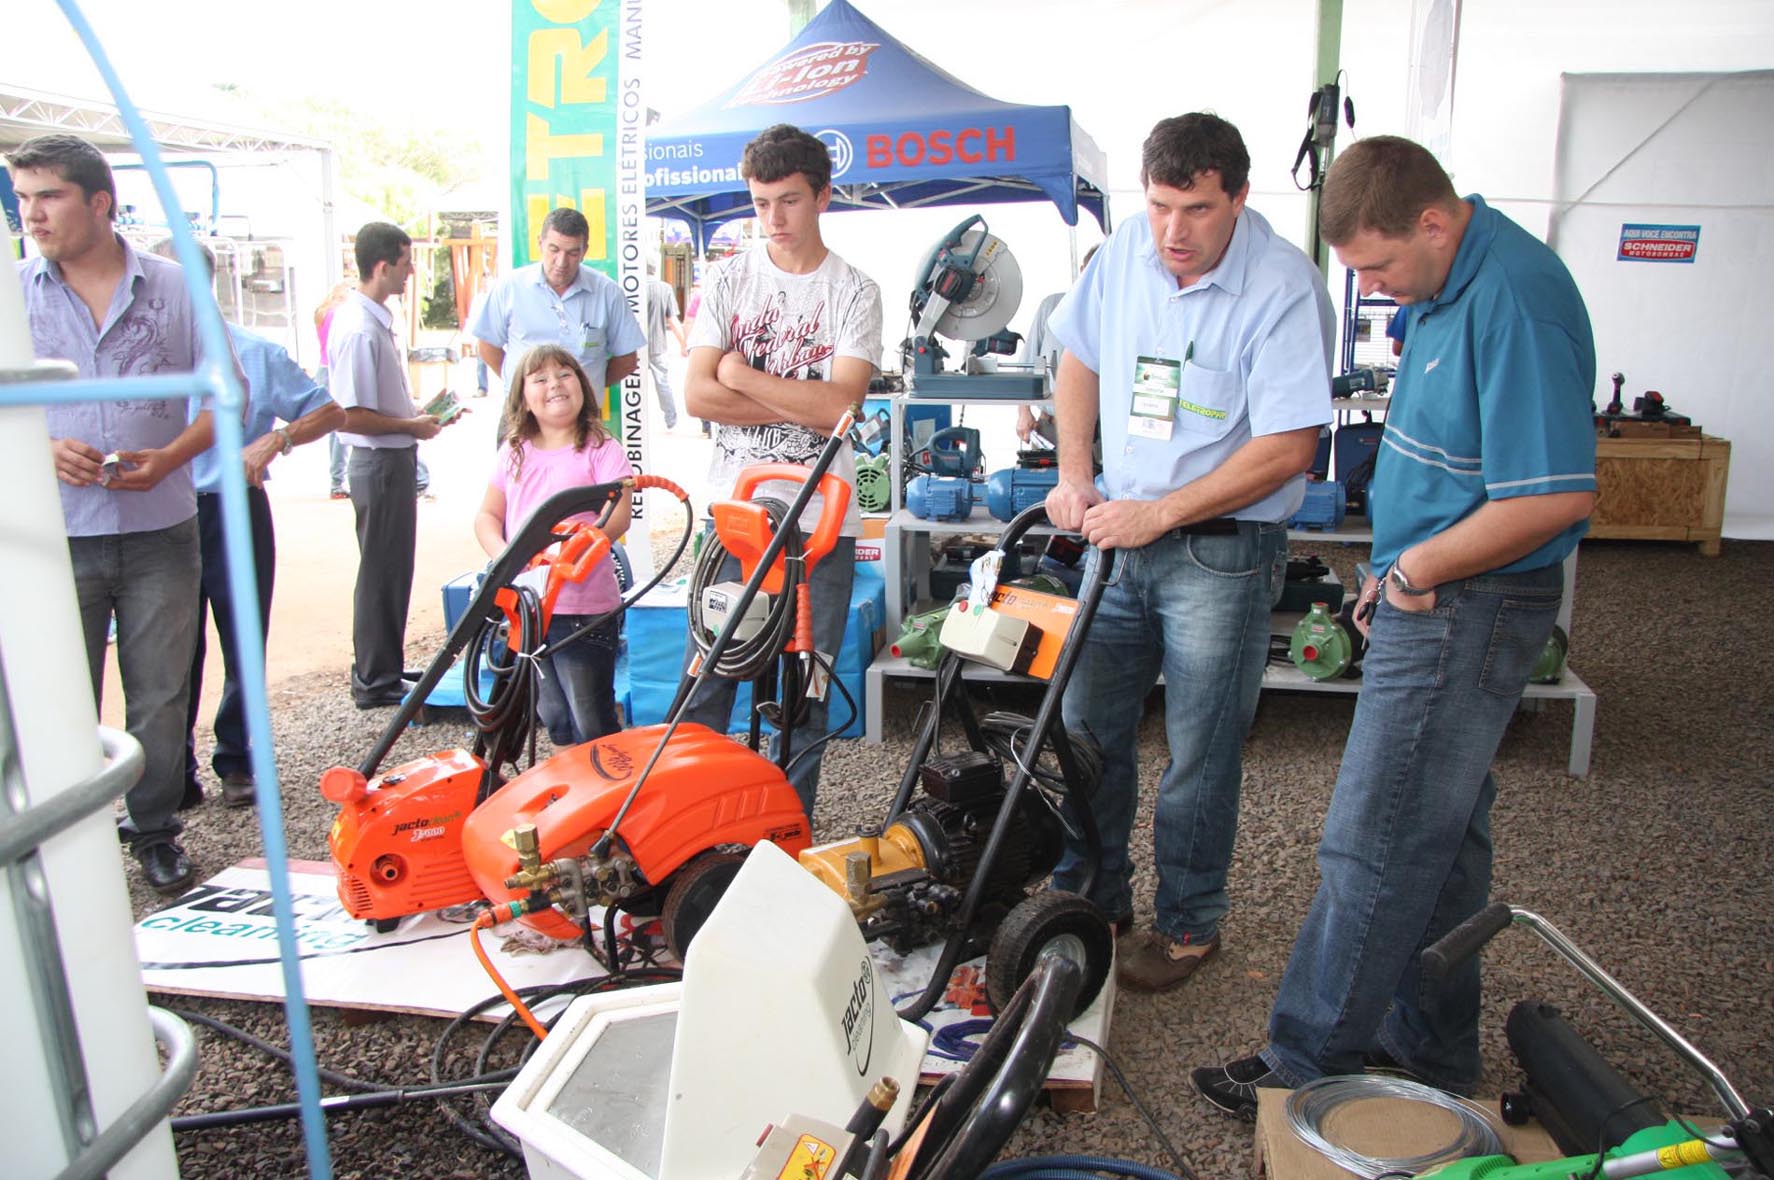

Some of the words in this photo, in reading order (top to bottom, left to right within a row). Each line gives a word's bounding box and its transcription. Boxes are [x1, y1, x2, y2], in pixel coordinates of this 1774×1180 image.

[865, 125, 1017, 169] BOSCH
[622, 203, 640, 313] MOTORES
[1623, 242, 1692, 252] SCHNEIDER
[841, 976, 868, 1056] jacto
